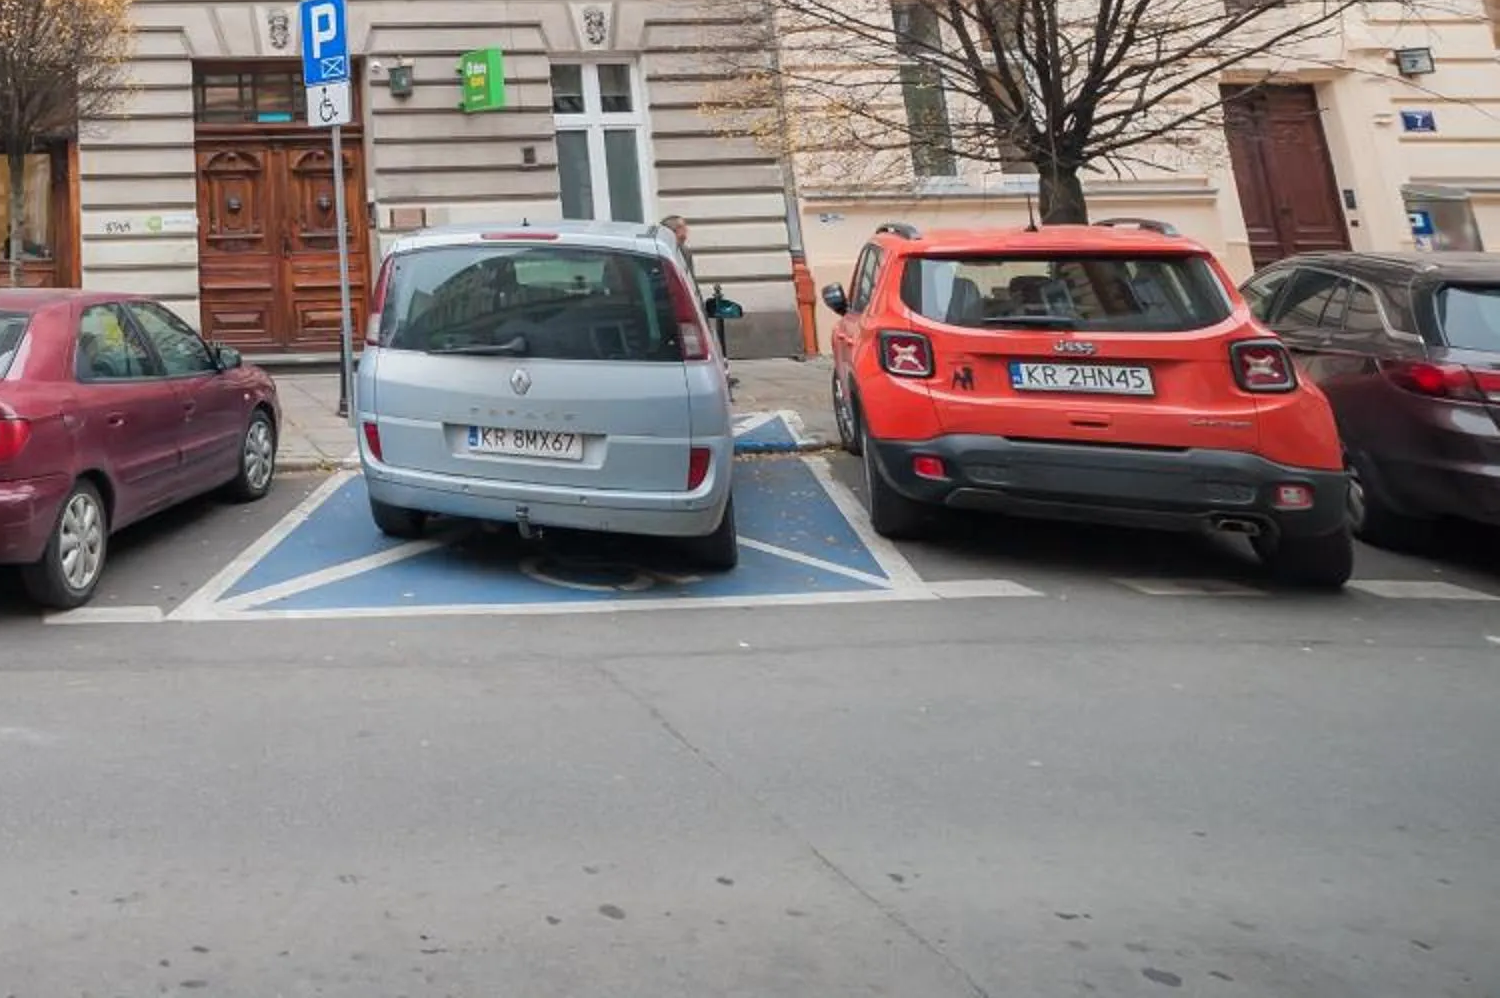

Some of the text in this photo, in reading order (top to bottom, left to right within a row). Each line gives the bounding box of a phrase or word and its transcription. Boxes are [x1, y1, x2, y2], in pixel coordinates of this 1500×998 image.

[311, 3, 337, 59] P
[1026, 366, 1145, 389] KR 2HN45
[482, 426, 575, 453] KR 8MX67
